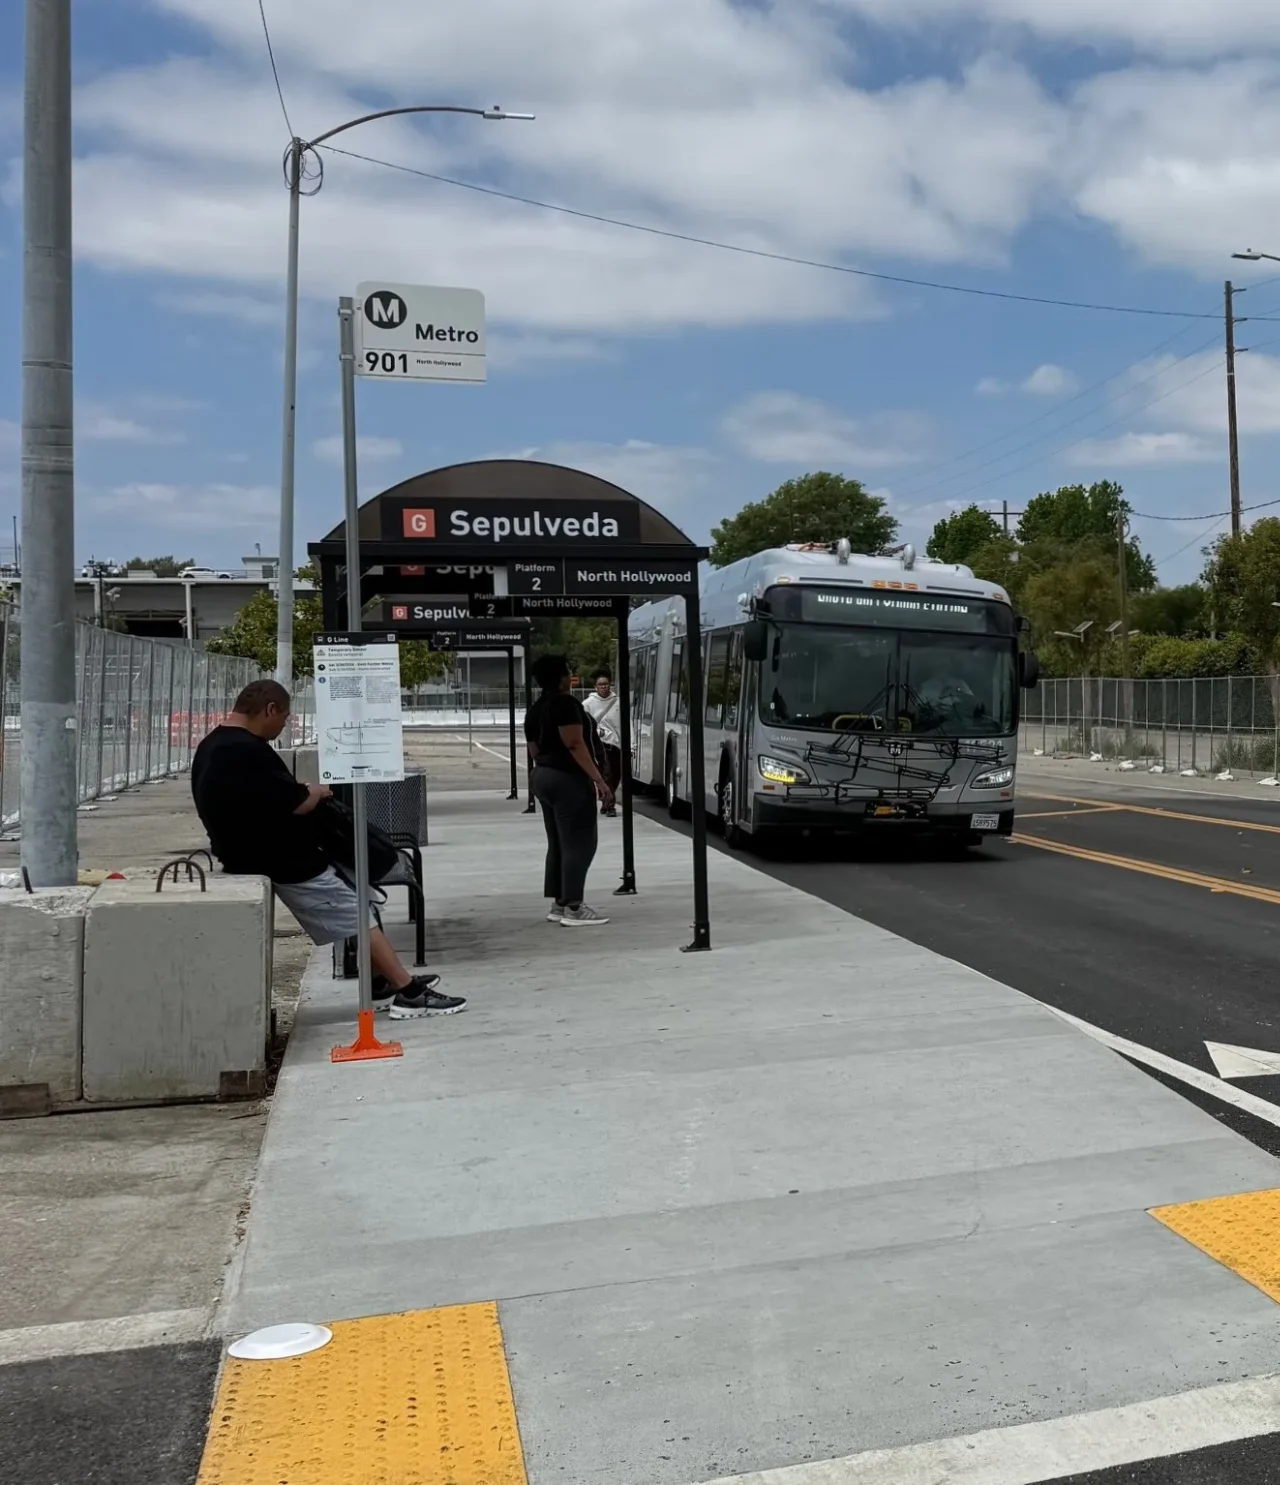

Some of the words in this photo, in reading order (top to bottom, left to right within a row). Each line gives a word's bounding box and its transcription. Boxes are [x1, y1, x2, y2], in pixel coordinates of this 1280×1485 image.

[370, 295, 401, 324] M
[415, 323, 479, 343] Metro
[365, 351, 408, 373] 901
[411, 514, 427, 532] G
[450, 509, 619, 542] Sepulveda
[515, 563, 556, 572] Platform
[577, 570, 617, 582] North
[620, 570, 692, 584] Hollywood
[531, 577, 542, 591] 2
[487, 604, 495, 614] 2
[523, 598, 554, 607] North
[556, 598, 612, 609] Hollywood
[396, 608, 404, 618] G
[445, 637, 450, 645] 2
[487, 633, 521, 641] Hollywood
